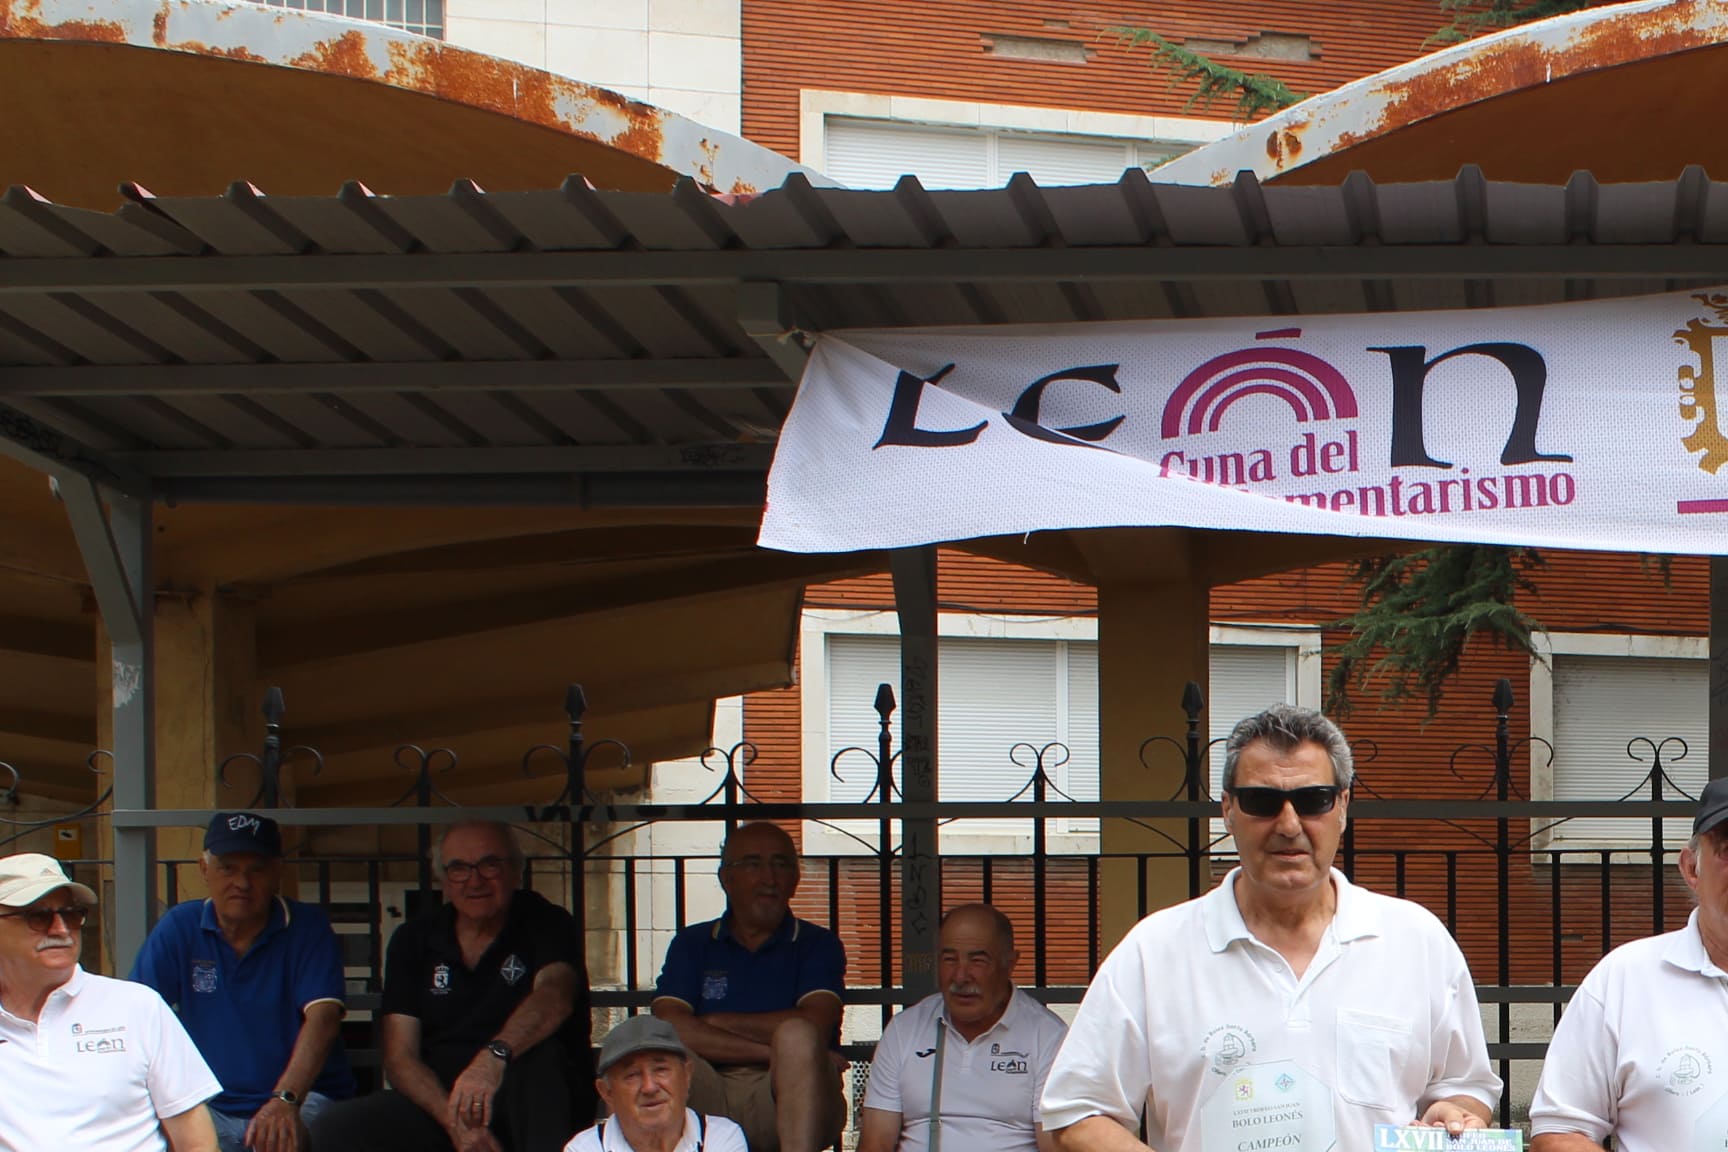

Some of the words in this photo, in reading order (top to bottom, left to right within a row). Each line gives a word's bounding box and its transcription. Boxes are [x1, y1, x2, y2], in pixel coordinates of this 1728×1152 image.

[1290, 429, 1359, 477] del
[1232, 1116, 1262, 1129] BOLO
[1237, 1132, 1302, 1152] CAMPEÓN
[1380, 1127, 1444, 1151] LXVII
